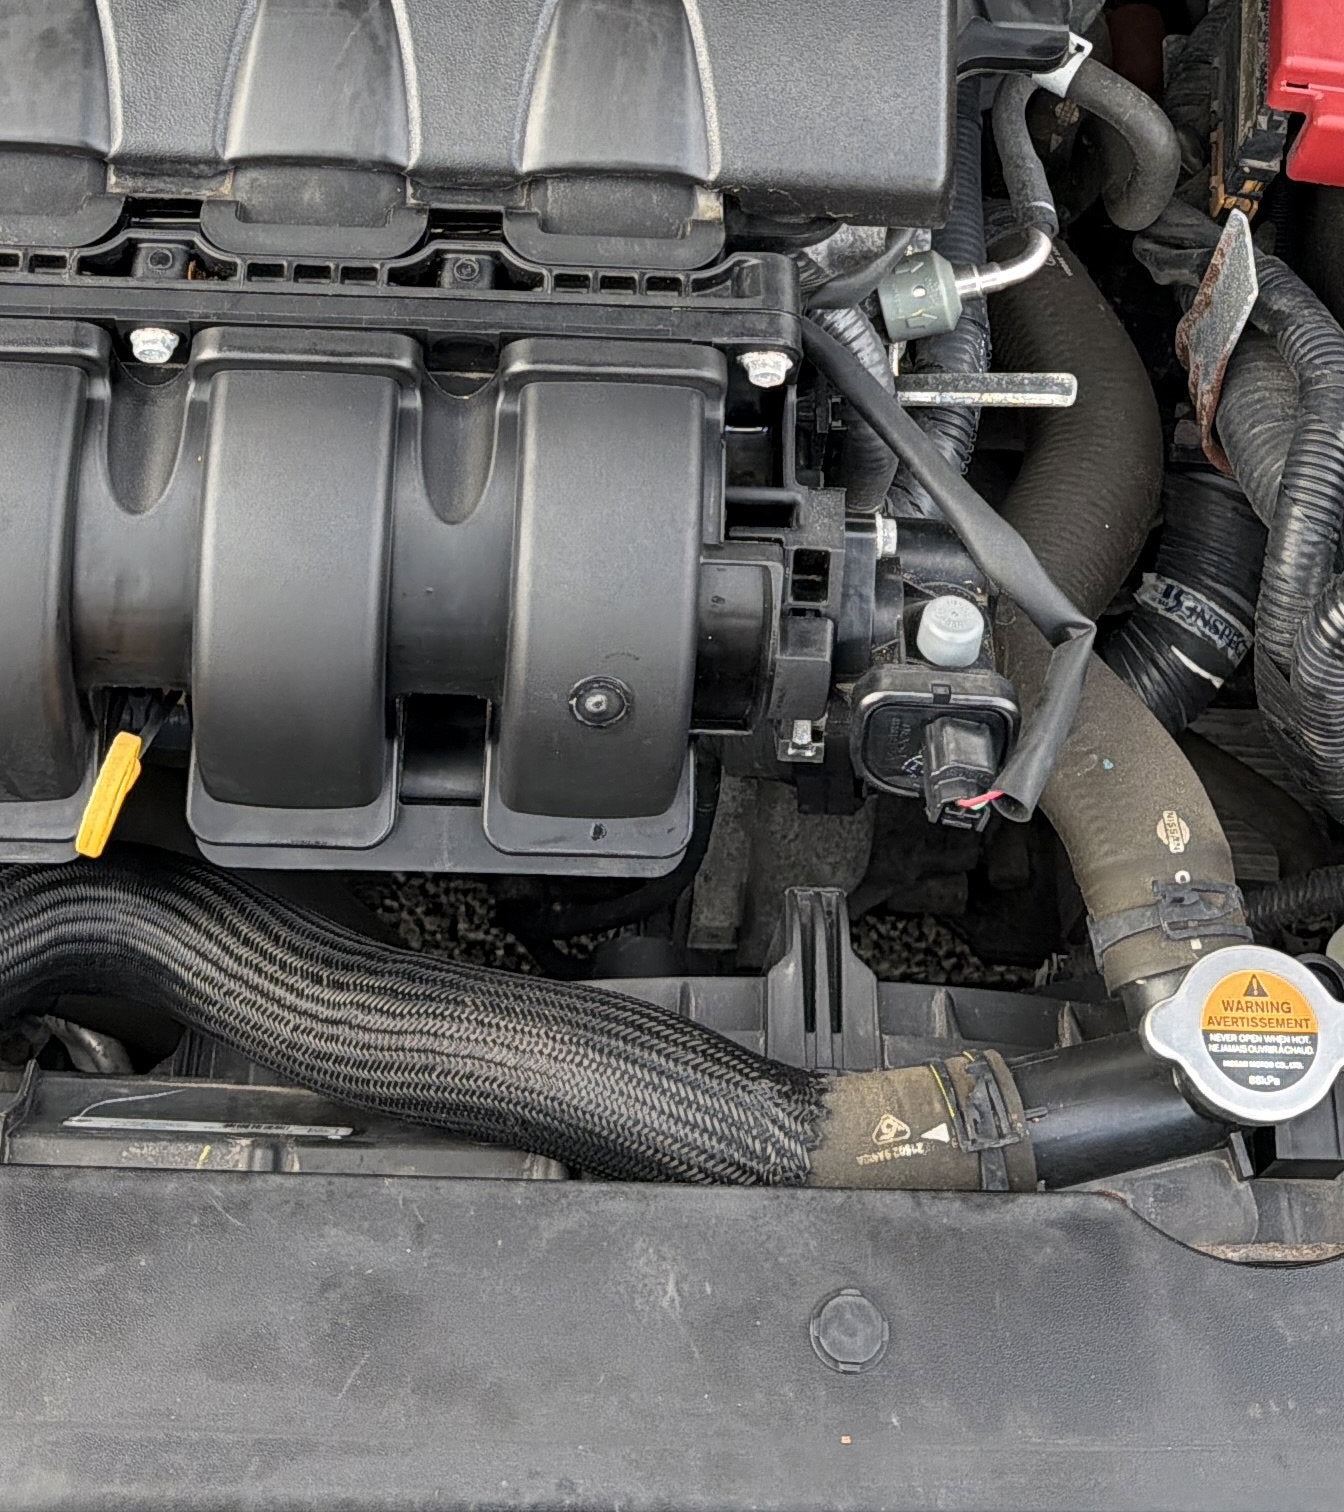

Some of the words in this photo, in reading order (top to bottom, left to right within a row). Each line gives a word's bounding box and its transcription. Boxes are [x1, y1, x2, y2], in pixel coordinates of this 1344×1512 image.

[1166, 811, 1181, 851] NISSAN
[1222, 999, 1292, 1014] WARNING
[1207, 1015, 1311, 1029] AVERTISSEMENT
[1209, 1033, 1238, 1043] NEVER
[1239, 1034, 1262, 1043] OPEN
[1263, 1035, 1290, 1044] WHEN
